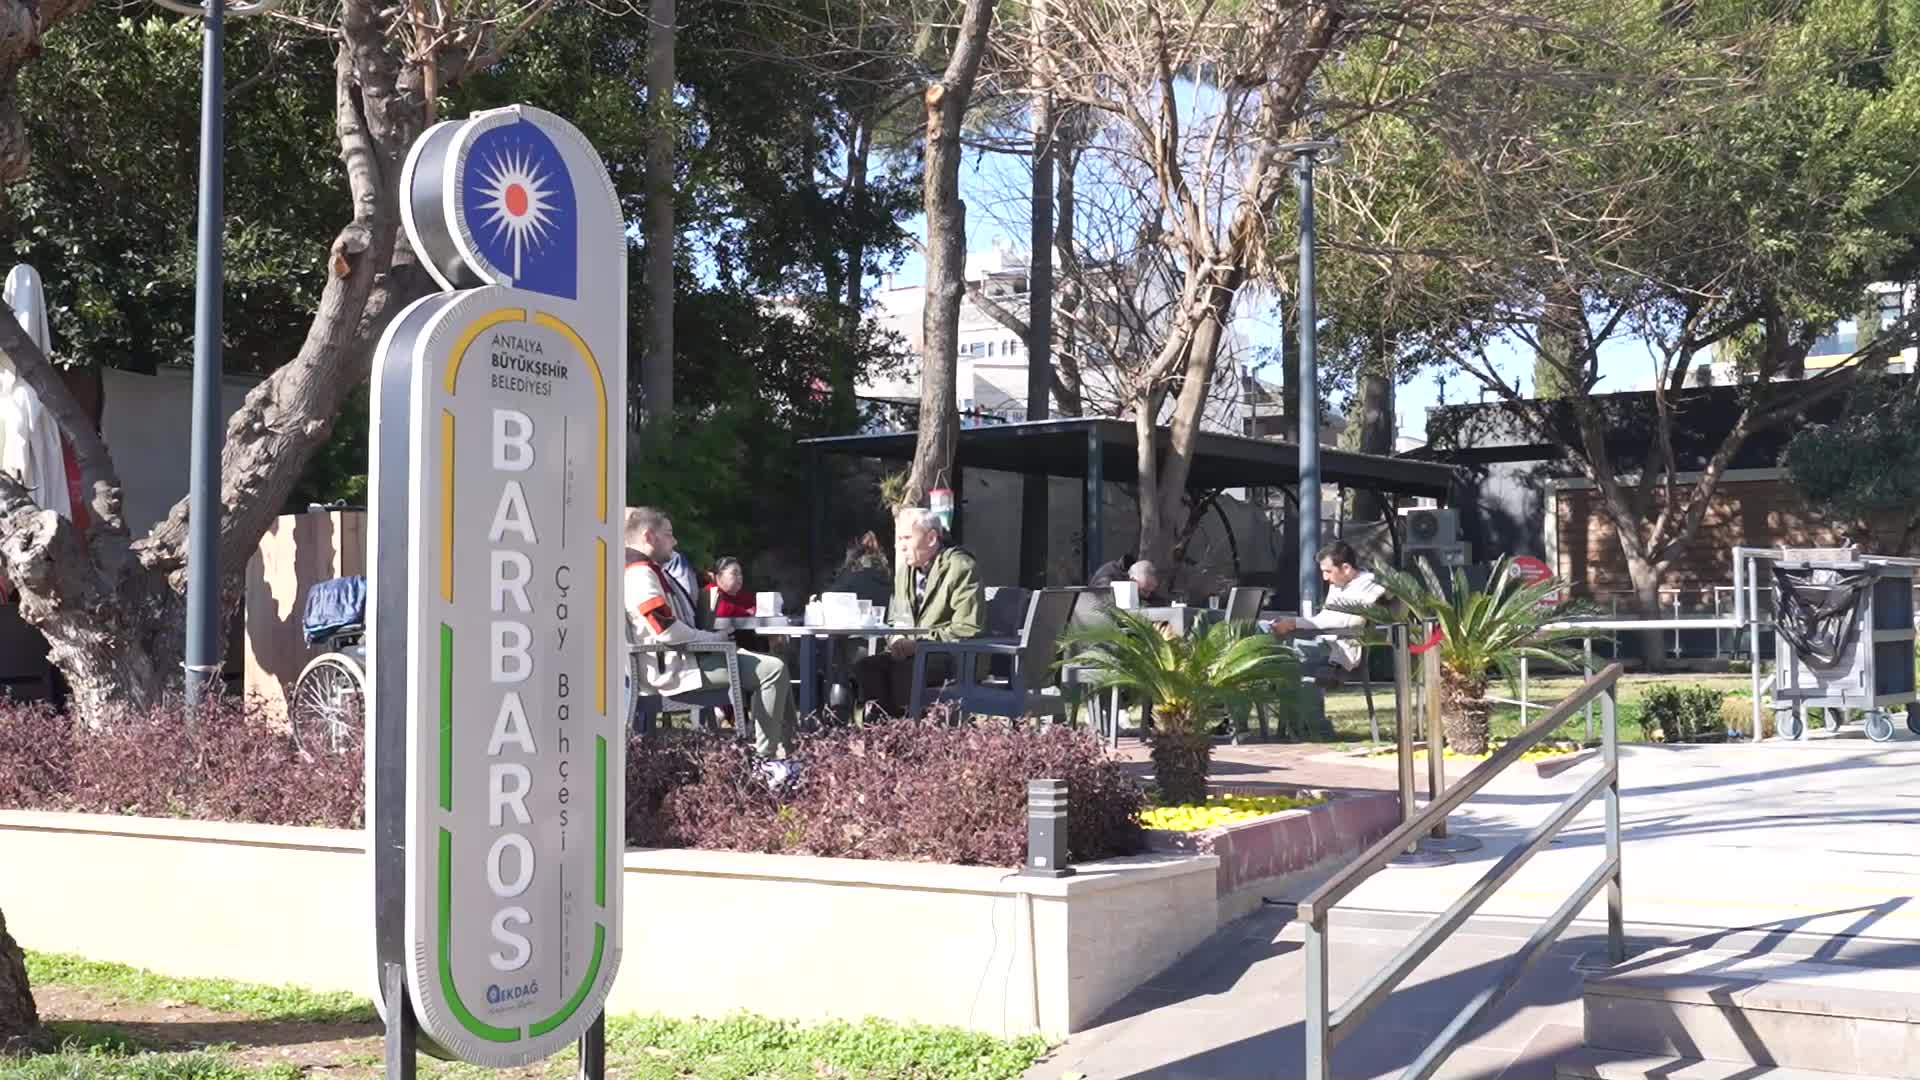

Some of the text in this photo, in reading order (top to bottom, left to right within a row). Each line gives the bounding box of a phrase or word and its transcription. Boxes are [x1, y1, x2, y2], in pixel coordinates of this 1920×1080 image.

[491, 333, 543, 355] ANTALYA
[491, 351, 568, 380] BÜYÜKŞEHİR
[491, 373, 552, 397] BELEDİYESİ
[487, 409, 540, 972] BARBAROS
[555, 565, 570, 851] Çay Bahçesi
